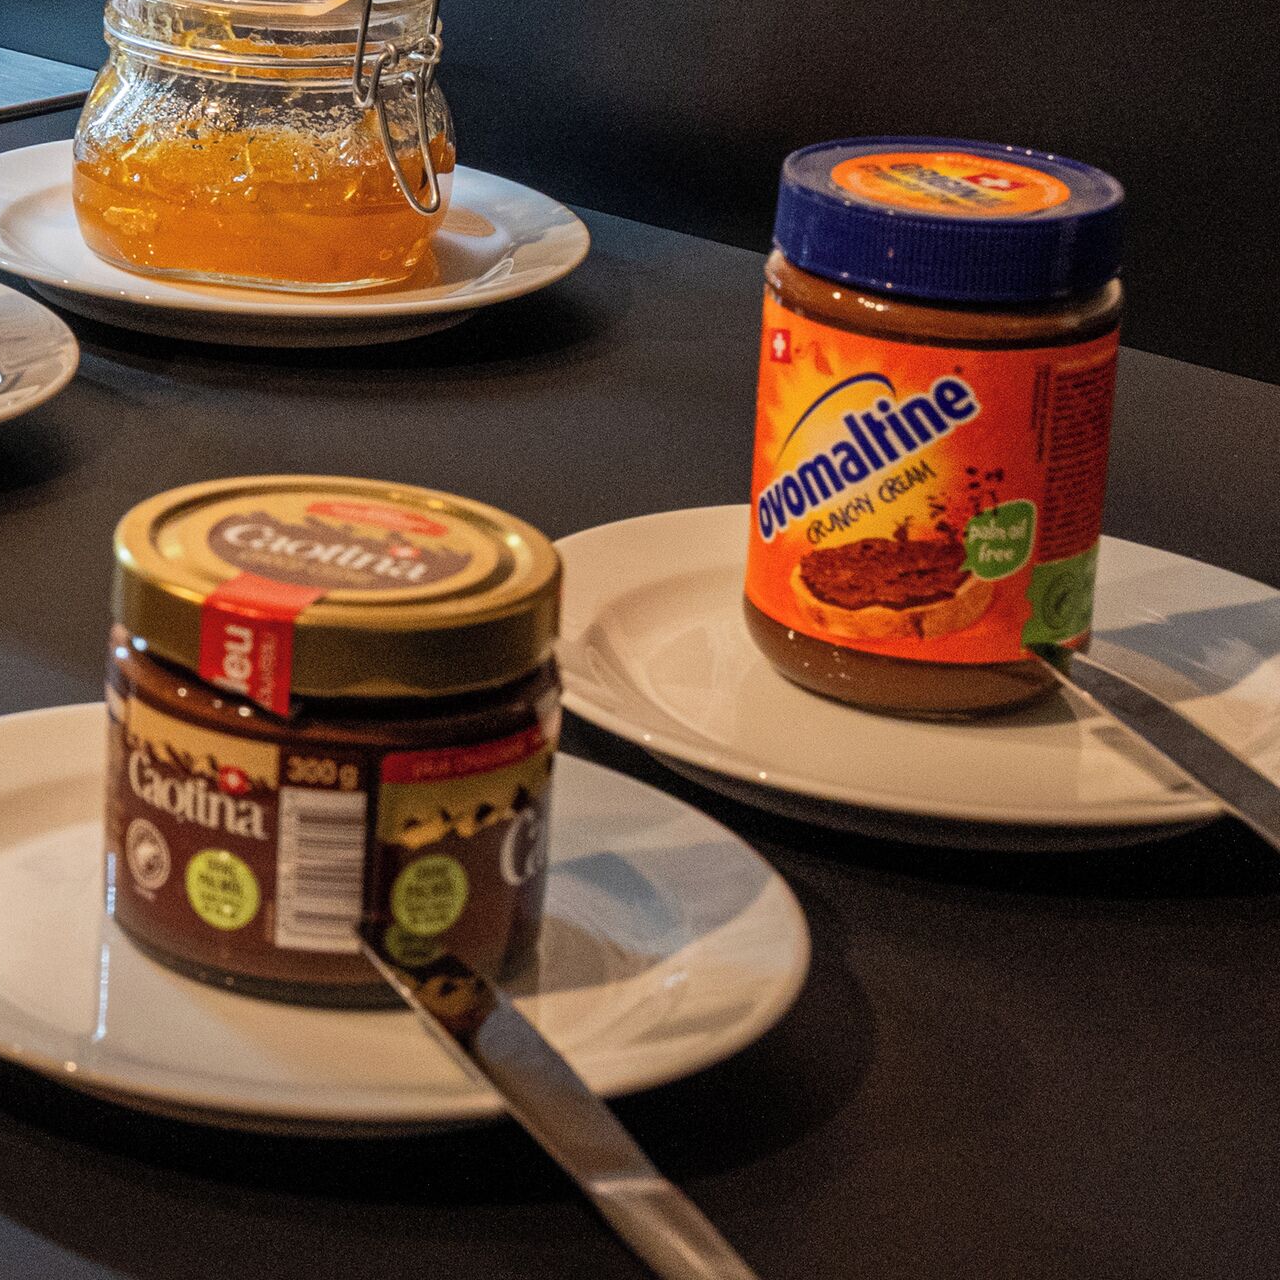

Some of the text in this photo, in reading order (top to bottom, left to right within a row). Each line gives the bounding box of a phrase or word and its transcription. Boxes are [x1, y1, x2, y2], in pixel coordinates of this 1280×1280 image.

[806, 459, 937, 545] CRUNCHY CREAM
[223, 522, 428, 581] Caotina
[978, 542, 1015, 562] free
[128, 748, 270, 841] Caotina
[339, 764, 359, 791] g
